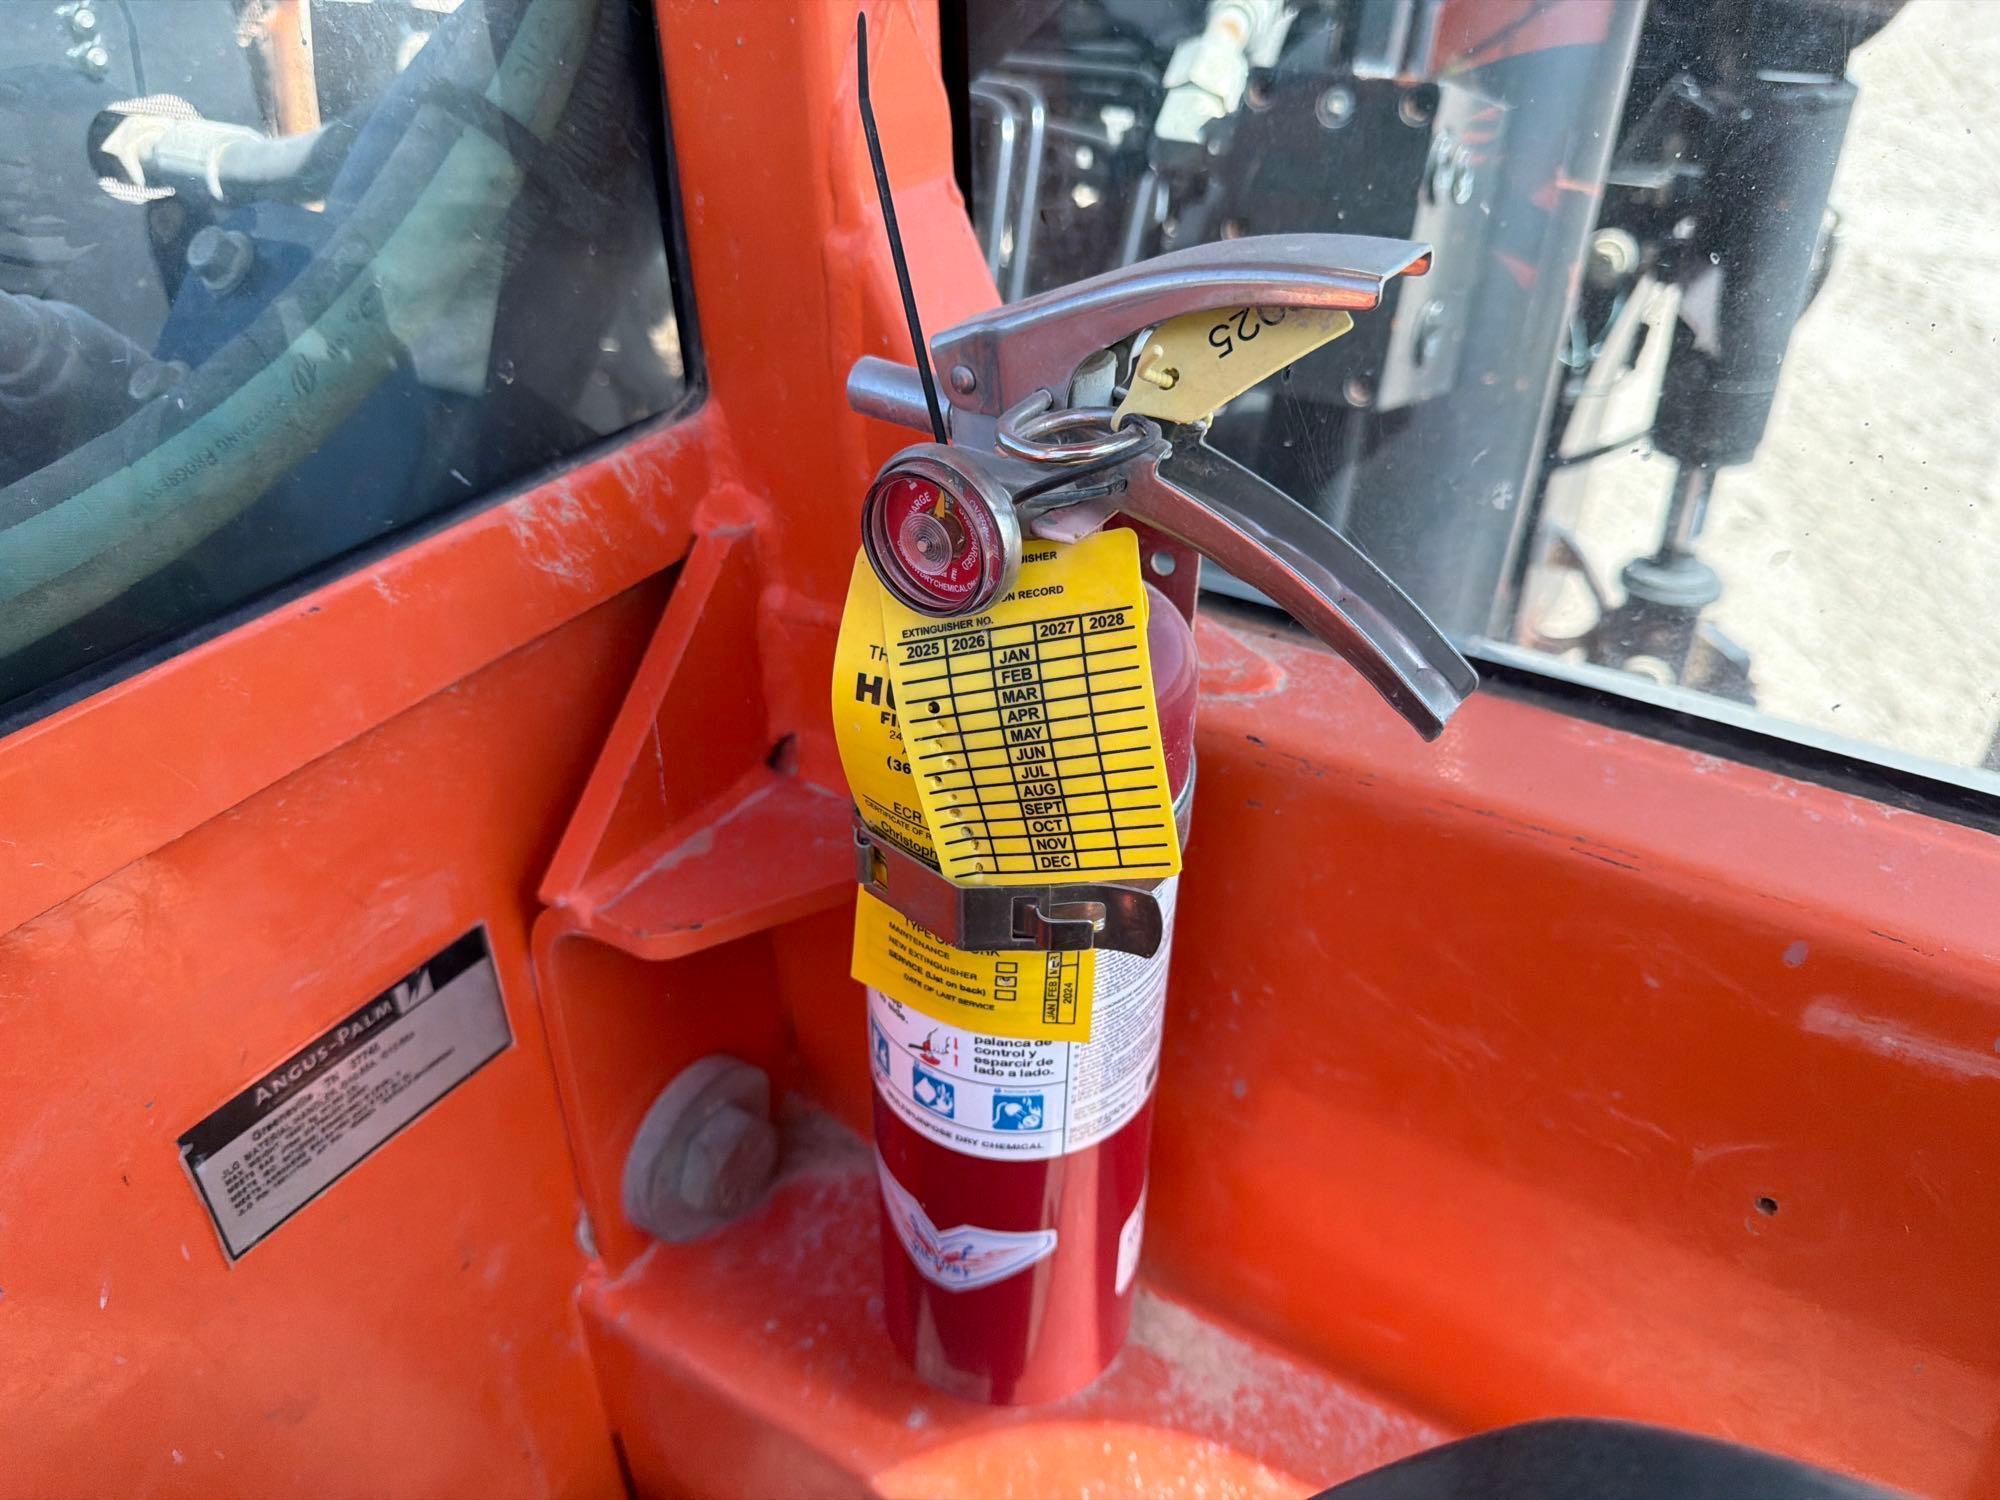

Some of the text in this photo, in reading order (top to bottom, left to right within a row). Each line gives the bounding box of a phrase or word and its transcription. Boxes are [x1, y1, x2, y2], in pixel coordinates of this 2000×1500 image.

[1208, 306, 1296, 359] 025
[908, 491, 932, 515] ARGE
[934, 579, 968, 593] CHEMICAL
[1001, 585, 1064, 603] N RECORD
[902, 616, 994, 640] EXTINGUISHER NO.
[1040, 620, 1075, 637] 2027
[1089, 613, 1125, 630] 2028
[906, 642, 940, 660] 2025
[952, 635, 985, 652] 2026
[999, 648, 1030, 664] JAN
[1001, 667, 1032, 684] FEB
[1002, 687, 1038, 704] MAR
[880, 711, 899, 729] FI
[1007, 707, 1040, 723] APR
[1010, 726, 1042, 742] MAY
[1016, 746, 1046, 761] JUN
[1021, 765, 1050, 779] JUL
[1024, 783, 1056, 797] AUG
[893, 801, 922, 823] ECR
[1024, 801, 1061, 815] SEPT
[865, 799, 910, 830] CERTIFICATE
[912, 826, 924, 837] OF
[1032, 820, 1062, 832] OCT
[881, 820, 938, 861] Christoph
[1036, 837, 1067, 850] NOV
[1041, 855, 1071, 868] DEC
[888, 921, 950, 960] MAINTENANCE
[888, 935, 907, 951] NEW
[908, 947, 977, 980] EXTINGUISHER
[888, 949, 923, 974] SERVICE
[945, 979, 957, 989] on
[960, 983, 986, 997] back)
[904, 972, 995, 1011] DATE OF LAST SERVICE
[1048, 981, 1058, 997] FEB
[1063, 982, 1073, 1005] 2024
[1047, 1003, 1056, 1020] JAN
[974, 1036, 1031, 1048] palanca
[255, 1001, 393, 1107] ANGUS-PALM
[974, 1046, 1037, 1059] control y
[974, 1057, 1053, 1068] esparcir de
[974, 1066, 1000, 1077] lado
[1019, 1068, 1054, 1077] lado.
[955, 1134, 978, 1146] DRY
[981, 1140, 1044, 1151] CHEMICAL
